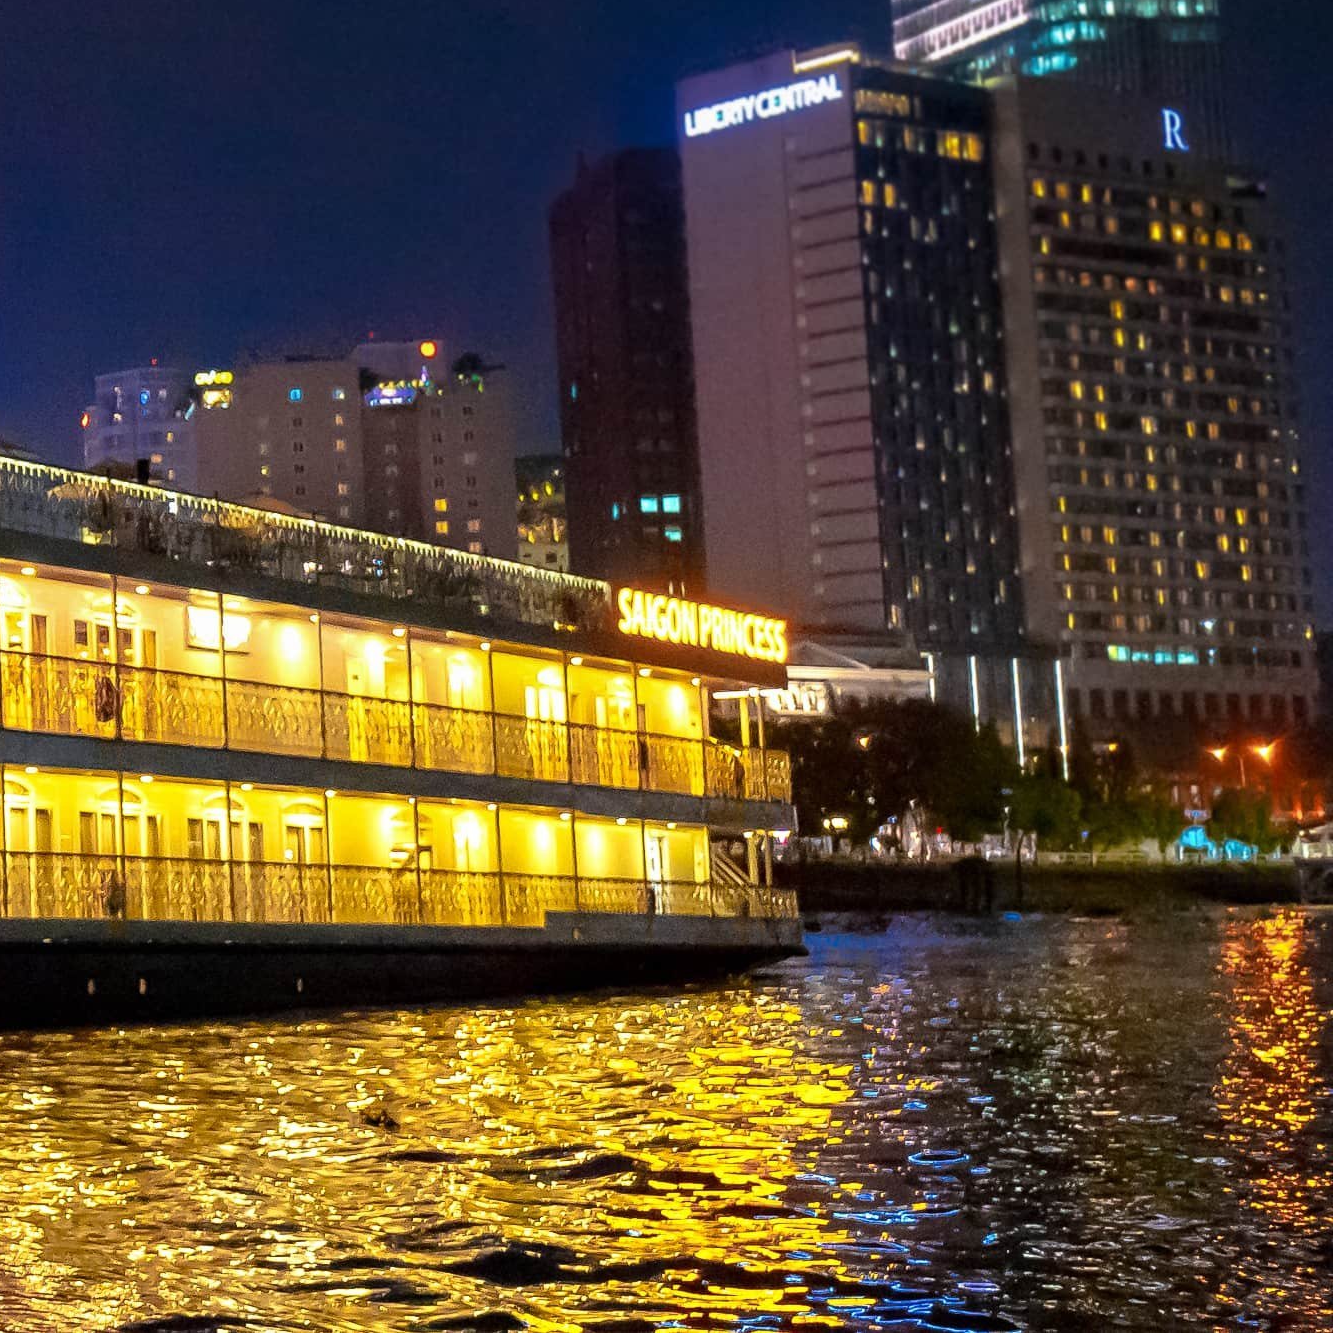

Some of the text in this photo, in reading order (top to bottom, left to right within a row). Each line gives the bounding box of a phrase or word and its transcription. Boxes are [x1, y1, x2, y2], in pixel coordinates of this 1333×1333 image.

[684, 73, 843, 138] LIBERTY CENTRAL
[1162, 107, 1190, 151] R
[617, 586, 789, 664] SAIGON PRINCESS
